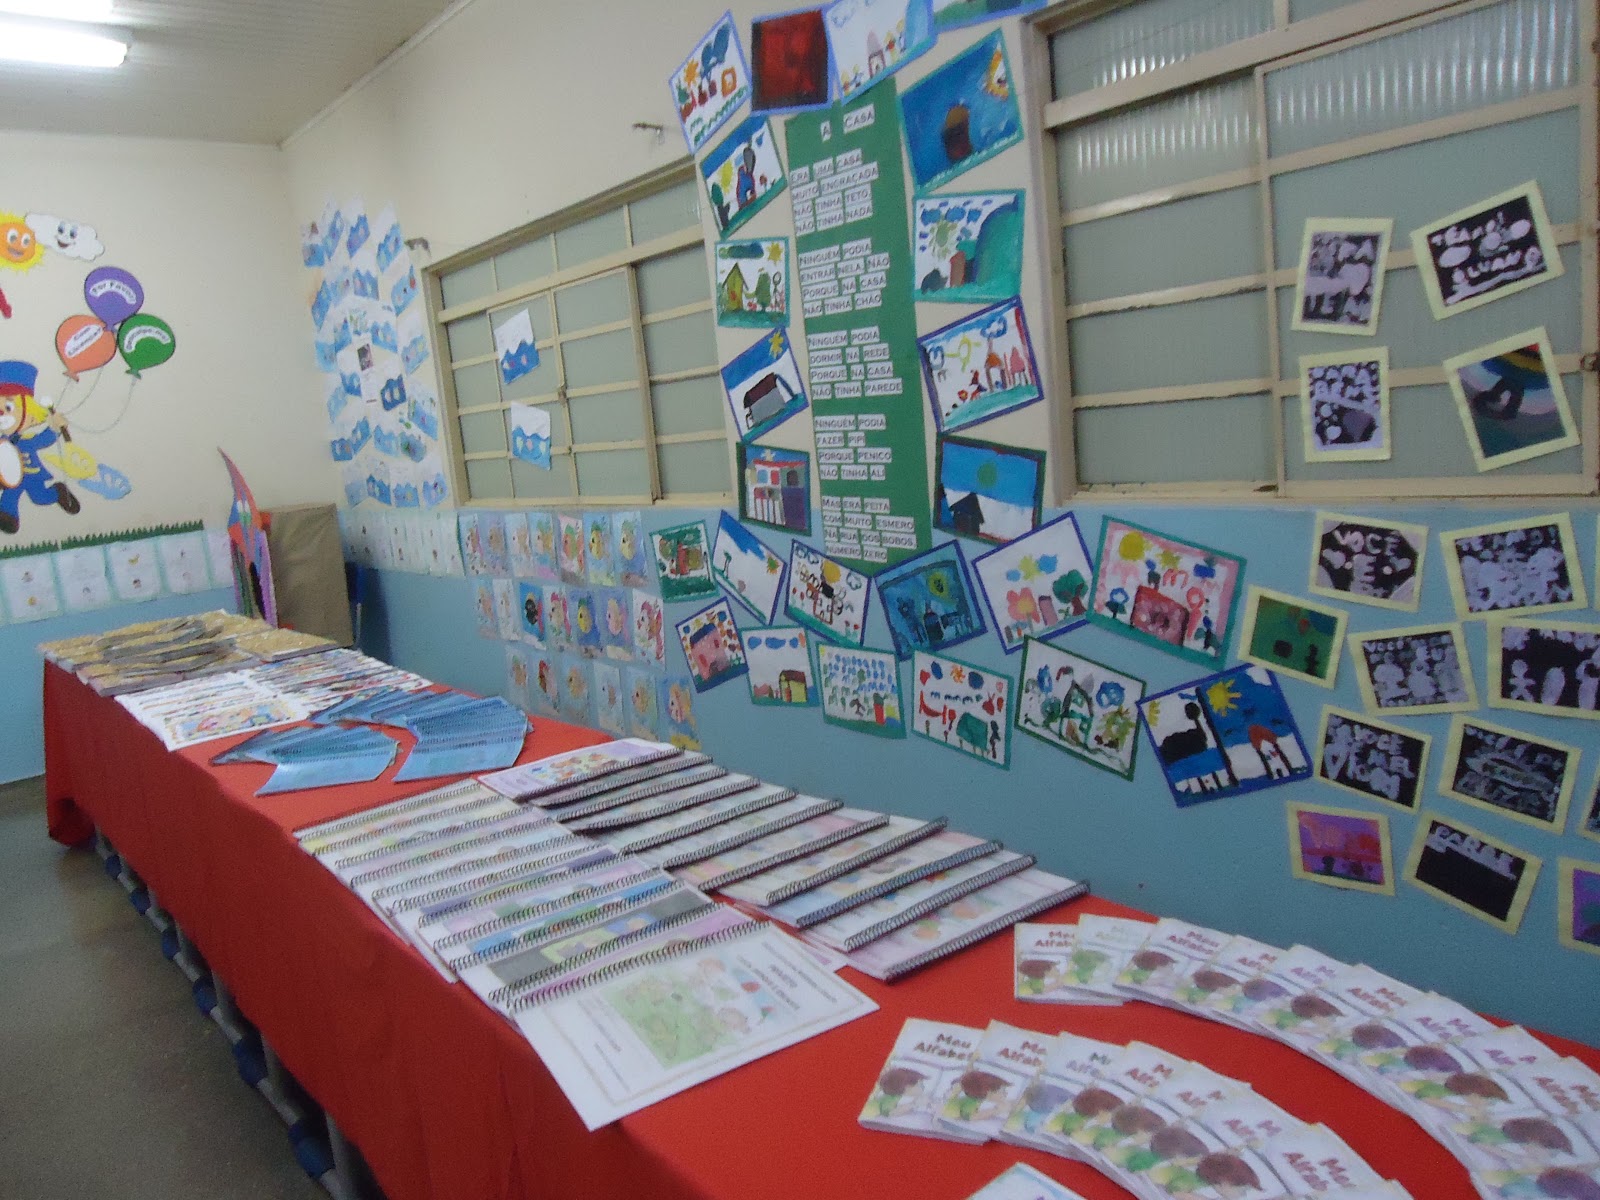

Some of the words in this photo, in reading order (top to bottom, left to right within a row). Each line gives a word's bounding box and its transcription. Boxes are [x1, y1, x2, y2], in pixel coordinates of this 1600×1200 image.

[845, 110, 874, 129] CASA
[837, 154, 861, 169] CASA
[816, 197, 842, 211] TINHA
[817, 212, 843, 227] TINHA
[847, 206, 871, 219] NADA
[844, 243, 870, 255] PODIA
[801, 268, 835, 280] ENTRAR
[803, 284, 837, 298] PORQUE
[861, 276, 884, 287] CASA
[826, 300, 851, 312] TINHA
[852, 331, 878, 340] PODIA
[810, 353, 842, 364] DORMIR
[864, 347, 889, 357] REDE
[811, 369, 847, 380] PORQUE
[867, 365, 892, 375] CASA
[836, 385, 861, 396] TINHA
[865, 381, 902, 393] PAREDE
[815, 417, 855, 429] NINGUÉM
[858, 418, 885, 428] PODIA
[817, 435, 843, 445] FAZER
[818, 451, 853, 461] PORQUE
[858, 451, 891, 461] PENICO
[842, 468, 868, 478] TINHA
[822, 498, 841, 508] MAS
[843, 500, 861, 509] ERA
[865, 502, 890, 511] FEITA
[823, 513, 842, 523] COM
[845, 517, 872, 527] MUITO
[877, 519, 914, 530] ESMERO
[862, 534, 880, 543] DOS
[864, 549, 888, 561] ZERO
